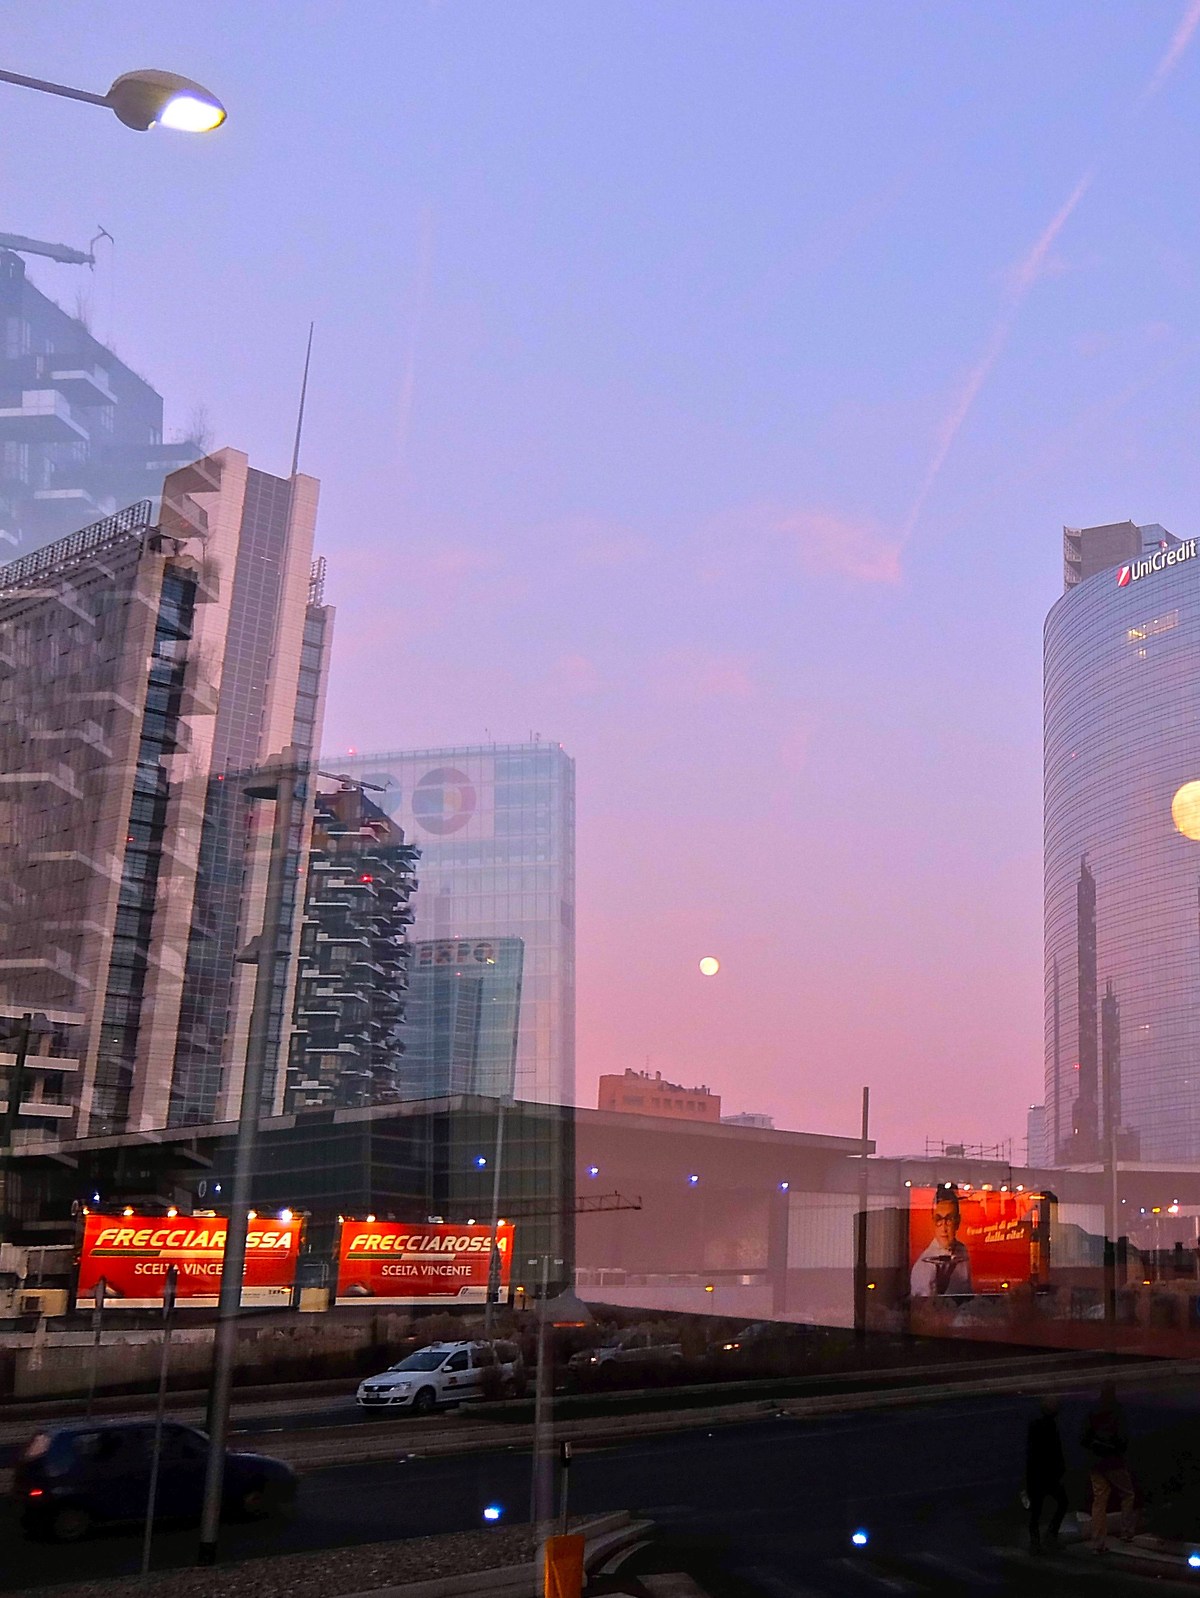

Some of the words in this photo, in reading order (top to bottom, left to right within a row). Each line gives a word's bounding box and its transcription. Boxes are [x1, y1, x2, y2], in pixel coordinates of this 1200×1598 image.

[1131, 540, 1197, 581] UniCredit
[94, 1228, 292, 1249] FRECCIARSSA
[183, 1263, 248, 1275] VINCEE
[381, 1265, 418, 1276] SCELTA
[420, 1265, 472, 1276] VINCENTE
